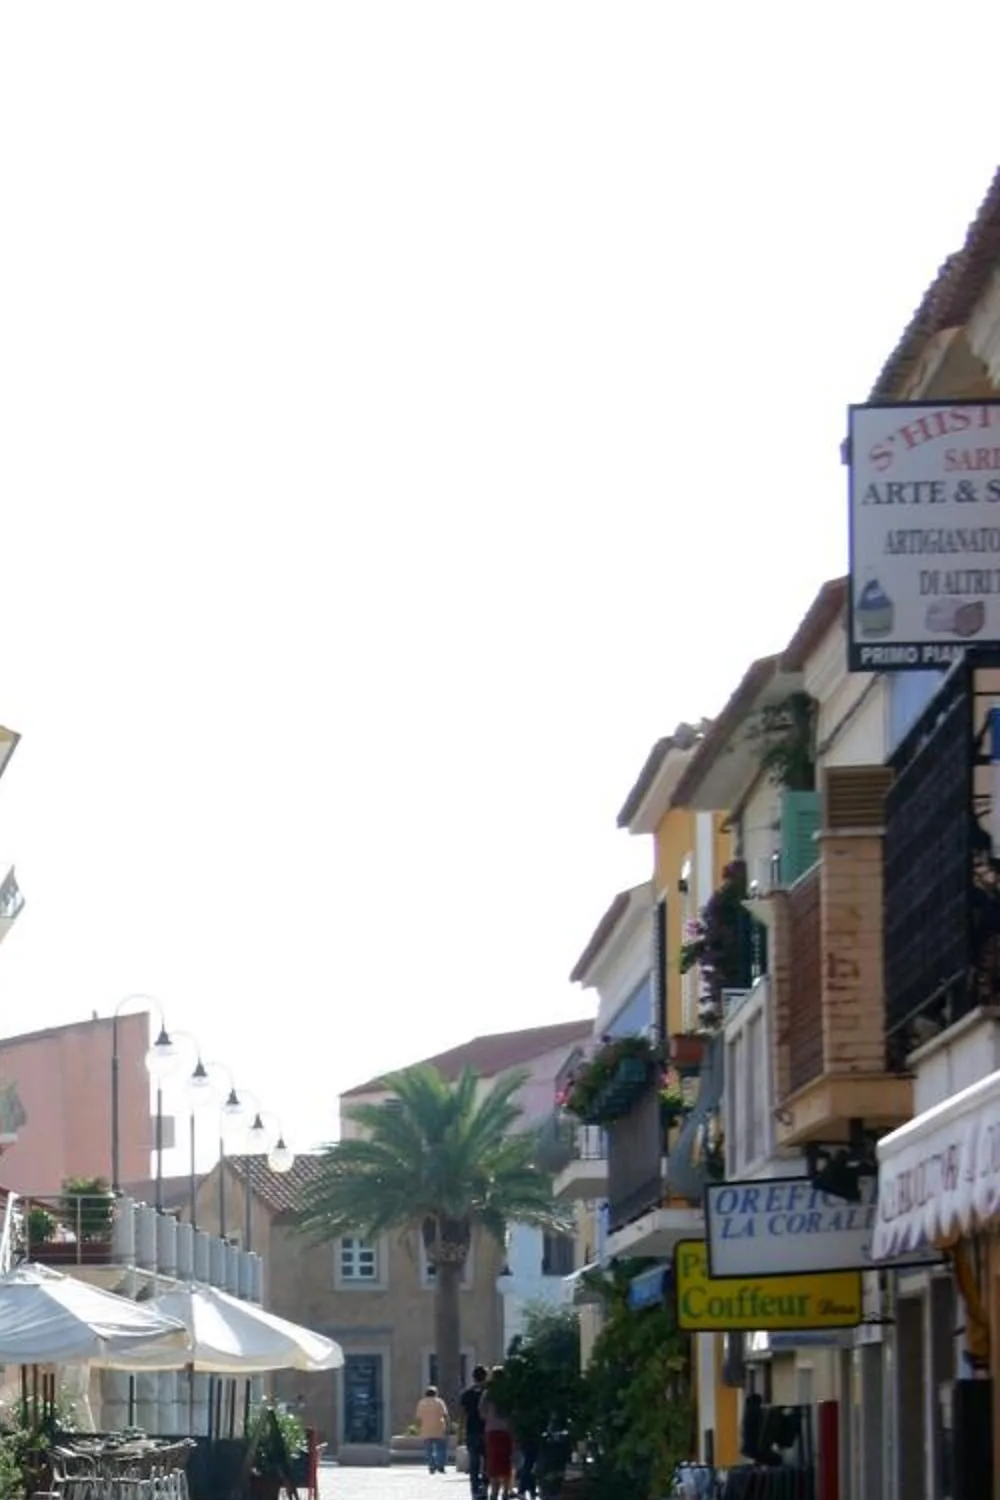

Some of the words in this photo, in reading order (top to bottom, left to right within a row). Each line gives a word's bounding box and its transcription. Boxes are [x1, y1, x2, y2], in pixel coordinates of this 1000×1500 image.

[868, 406, 1000, 473] S'HIST
[861, 480, 947, 505] ARTE
[953, 479, 978, 503] &
[860, 646, 918, 664] PRIMO
[720, 1216, 756, 1240] LA
[682, 1285, 811, 1320] Coiffeur
